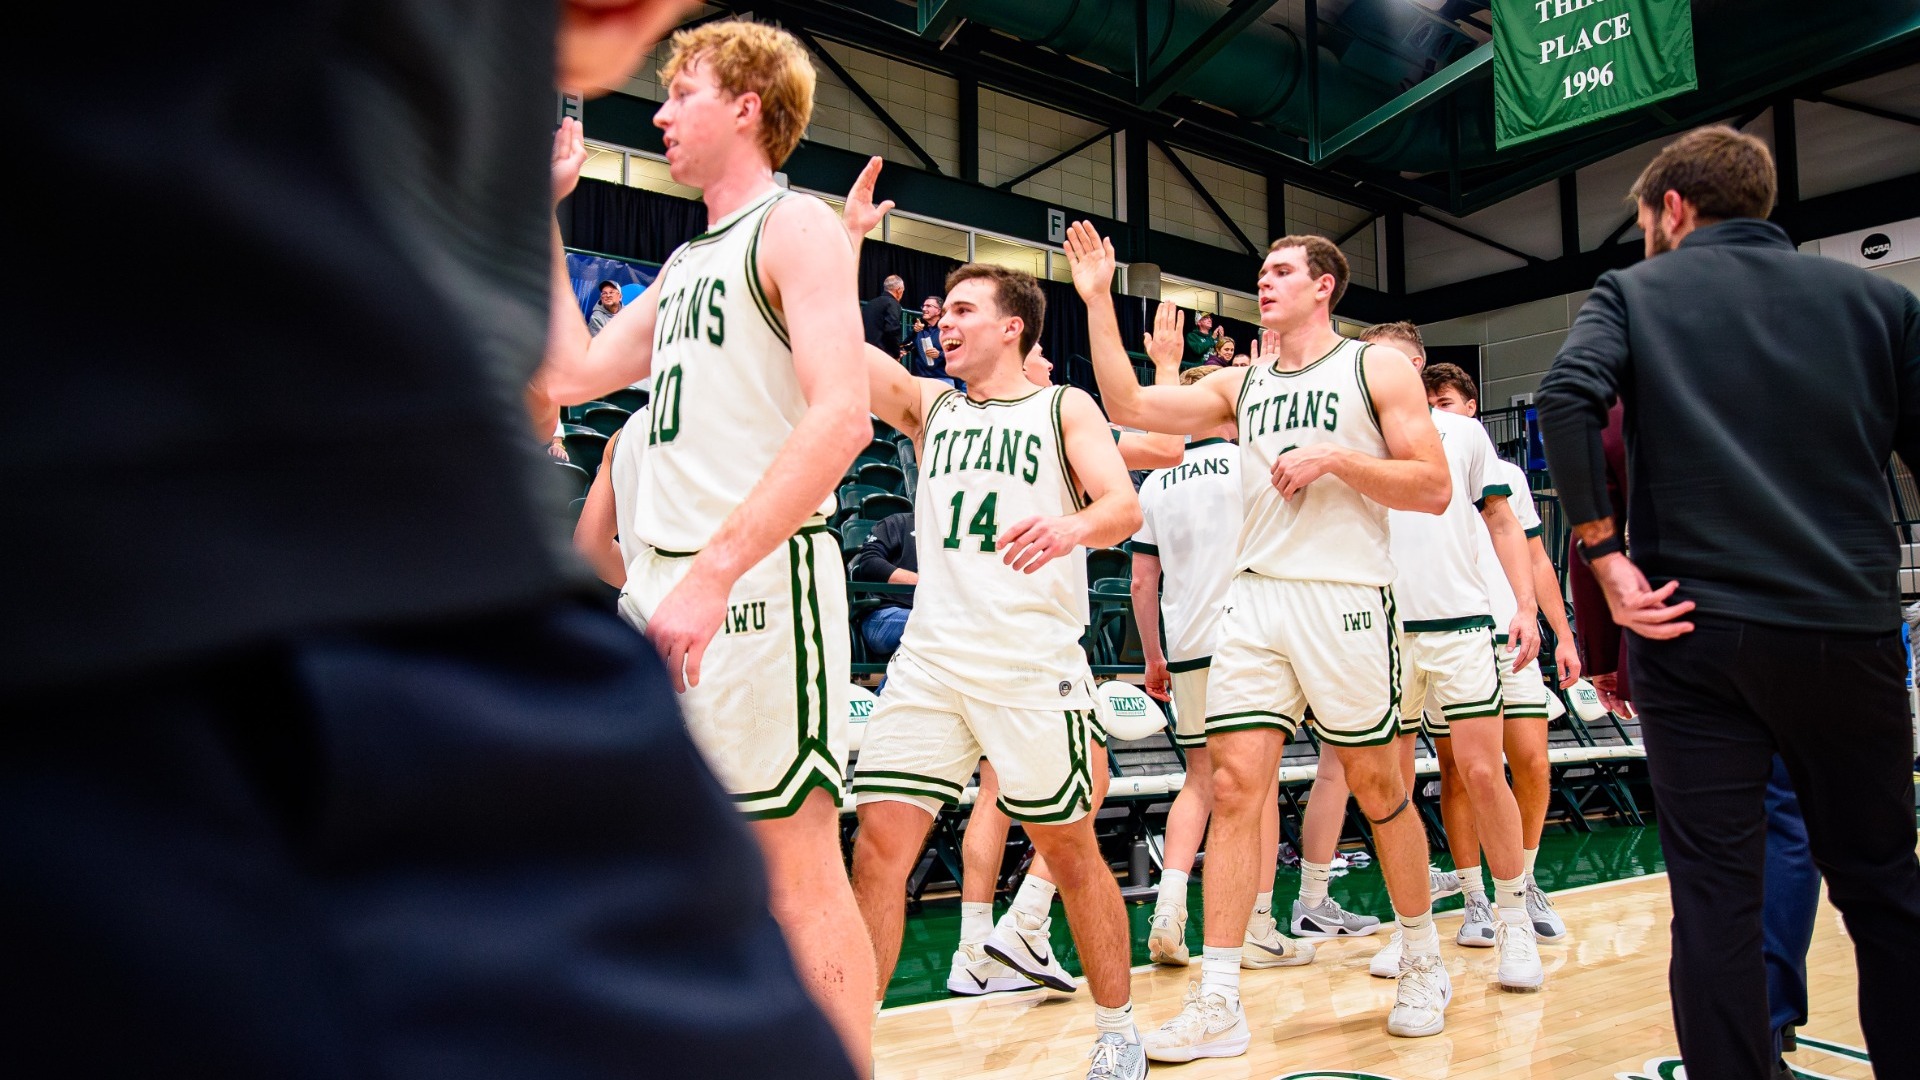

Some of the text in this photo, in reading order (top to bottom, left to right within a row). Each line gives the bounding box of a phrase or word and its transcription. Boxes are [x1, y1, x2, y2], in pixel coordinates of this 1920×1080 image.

[1535, 0, 1605, 23] THI
[1539, 13, 1631, 65] PLACE
[1562, 60, 1614, 99] 1996
[1051, 214, 1061, 236] F
[1863, 243, 1890, 256] NCAA
[657, 277, 726, 351] TITNS
[648, 363, 683, 442] 10
[1246, 390, 1339, 443] TITANS
[928, 425, 1042, 485] TITANS
[1159, 457, 1230, 490] TITANS
[943, 490, 998, 553] 14
[725, 601, 766, 635] IWU
[1342, 611, 1372, 631] IWU
[1109, 696, 1146, 711] TITANS
